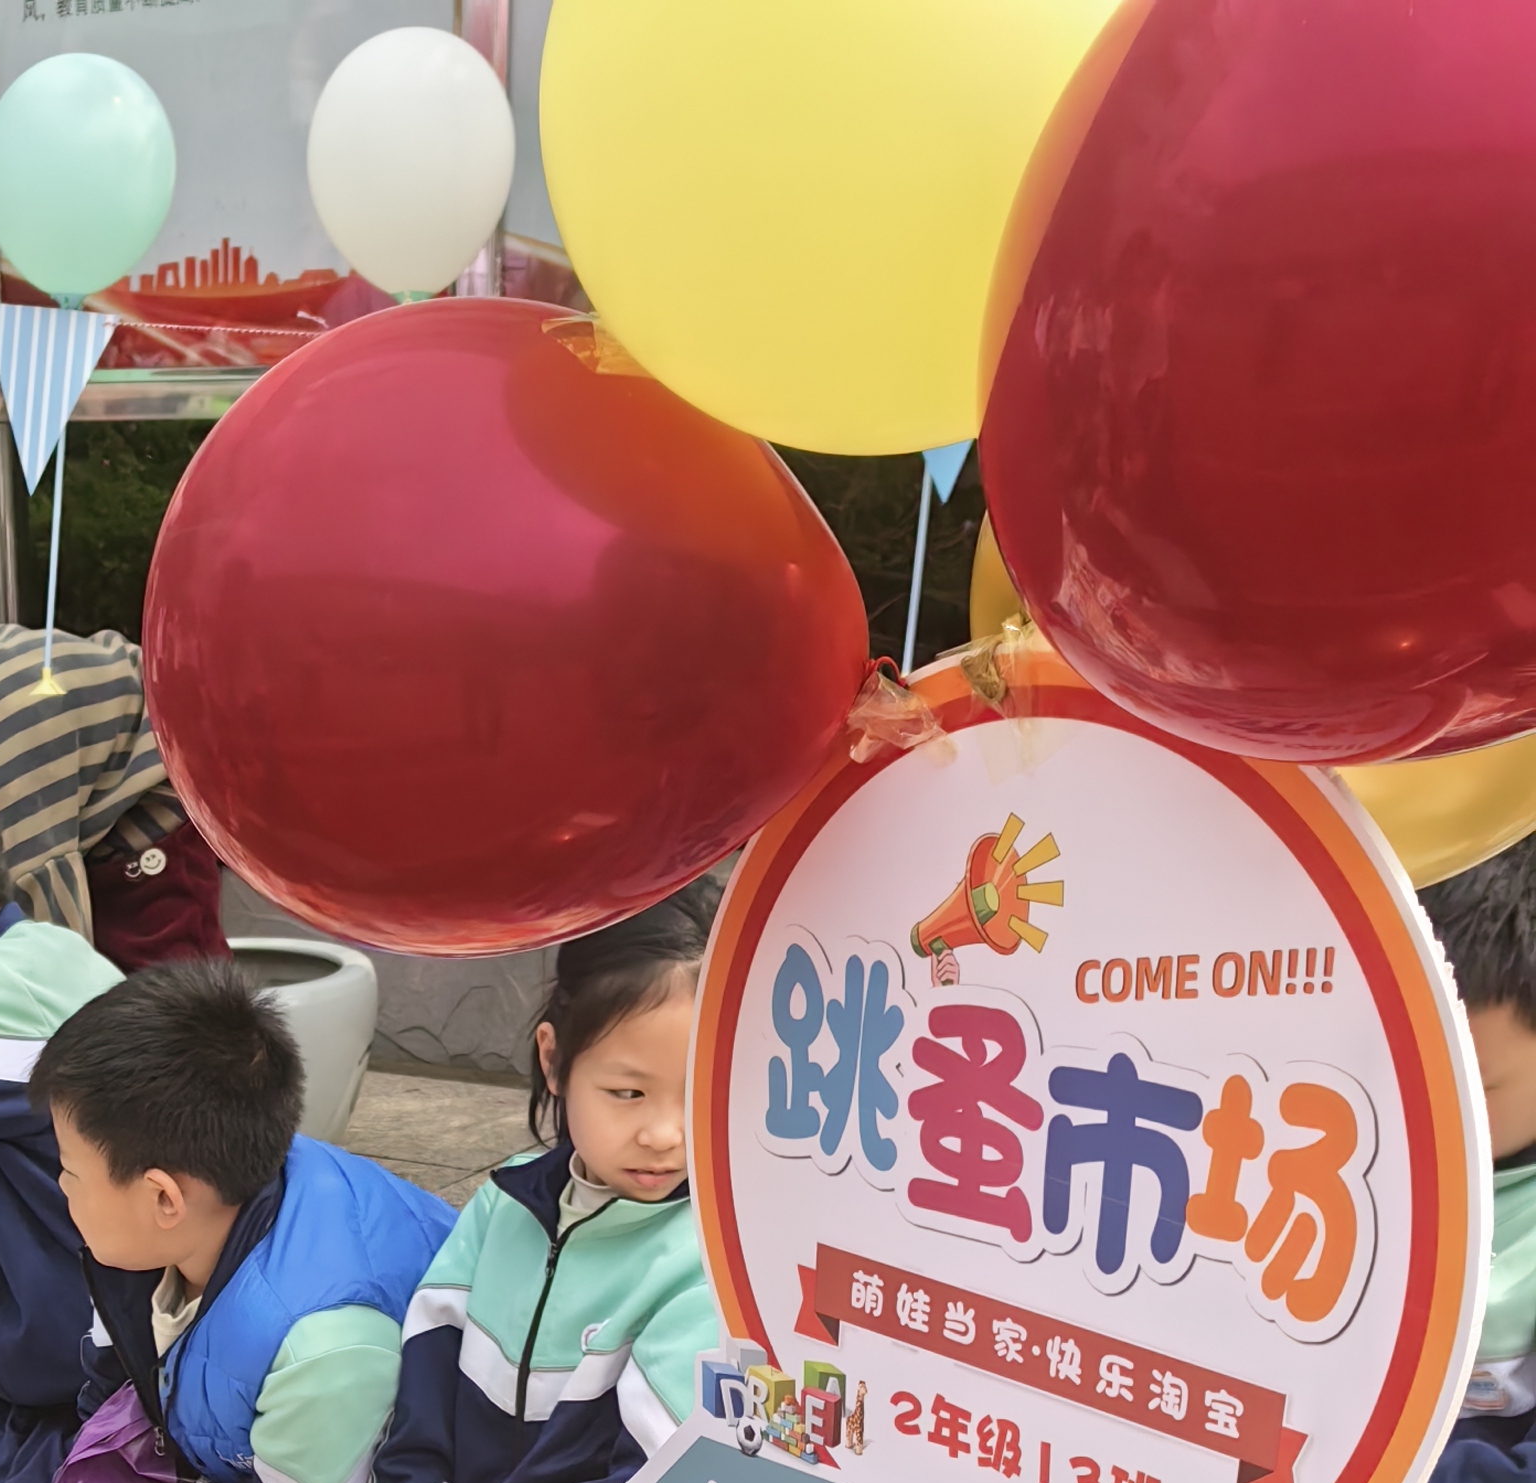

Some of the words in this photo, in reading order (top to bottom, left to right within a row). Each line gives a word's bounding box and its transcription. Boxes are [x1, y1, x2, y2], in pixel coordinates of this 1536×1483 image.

[1075, 955, 1200, 1004] COME
[1212, 946, 1336, 998] ON!!!
[764, 941, 1359, 1324] 跳蚤市场
[849, 1268, 1245, 1440] 萌娃当家·快乐淘宝
